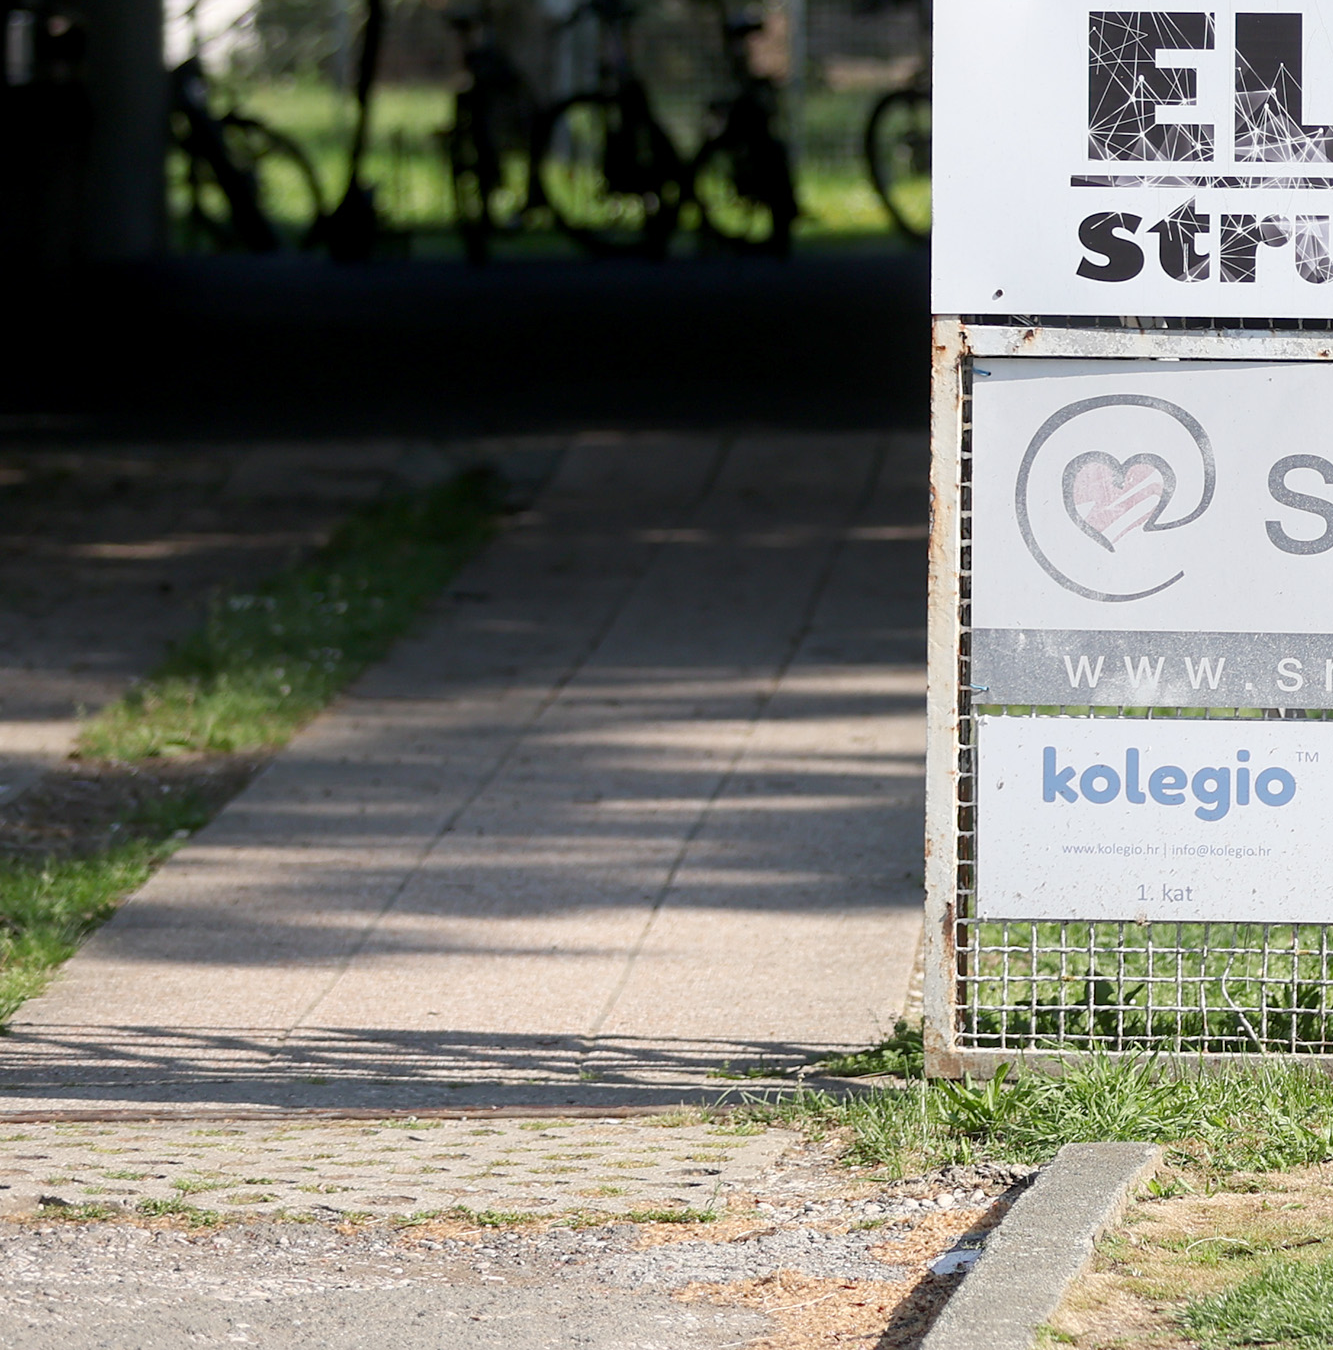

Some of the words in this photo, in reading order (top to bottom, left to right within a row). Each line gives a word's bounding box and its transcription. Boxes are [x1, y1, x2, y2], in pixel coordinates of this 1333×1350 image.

[1042, 746, 1297, 822] kolegio
[1062, 843, 1160, 857] www.kolegio.hr
[1171, 843, 1272, 859] info@kolegio.hr
[1136, 884, 1154, 902] 1.
[1162, 883, 1194, 902] kat
